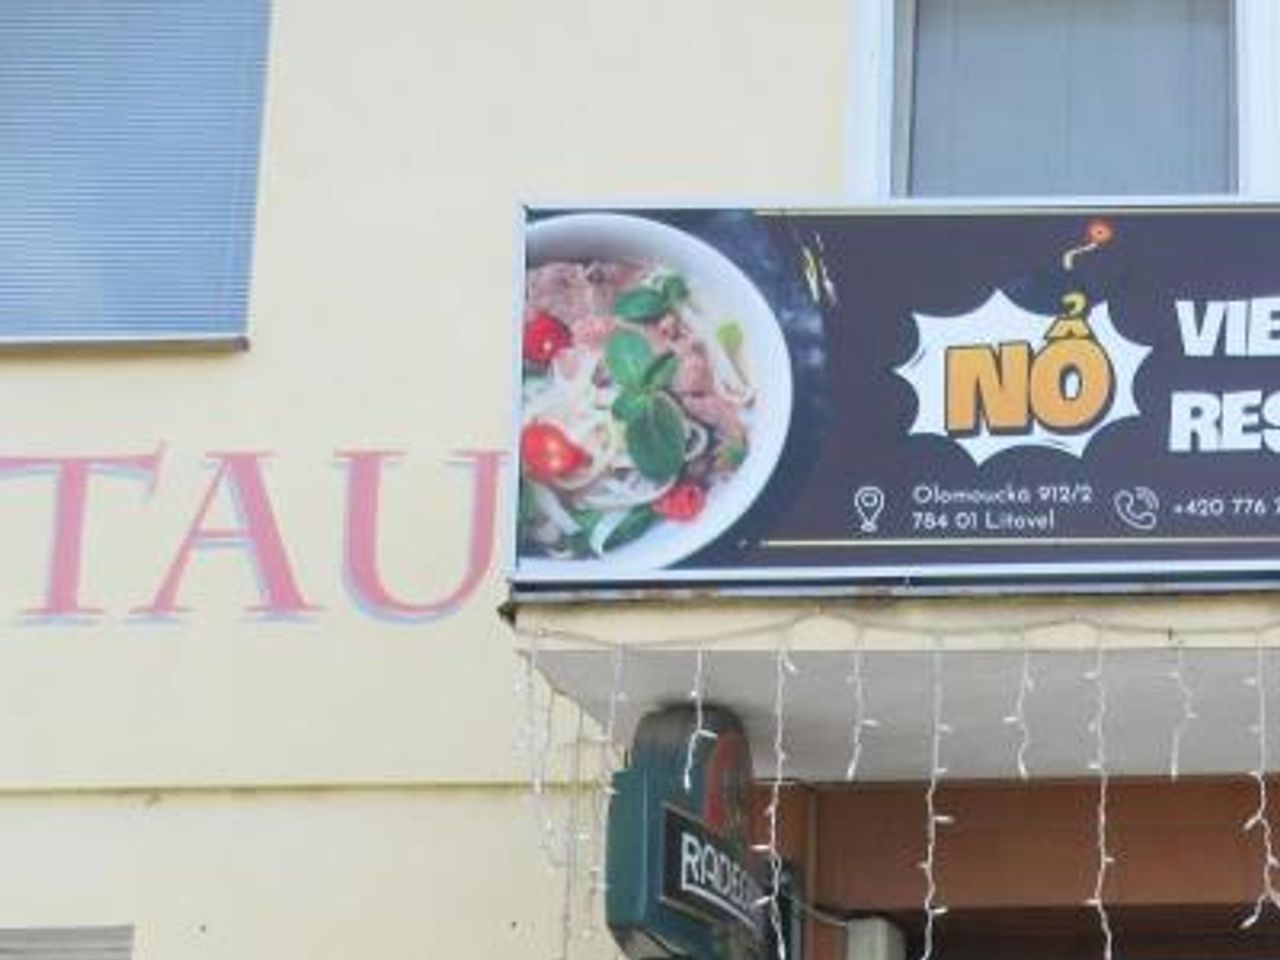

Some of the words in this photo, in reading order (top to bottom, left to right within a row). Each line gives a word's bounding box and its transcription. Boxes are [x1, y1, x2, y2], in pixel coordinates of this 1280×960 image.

[1232, 497, 1267, 515] 776
[911, 511, 949, 531] 784
[955, 511, 978, 531] 01
[985, 507, 1055, 531] Litovel
